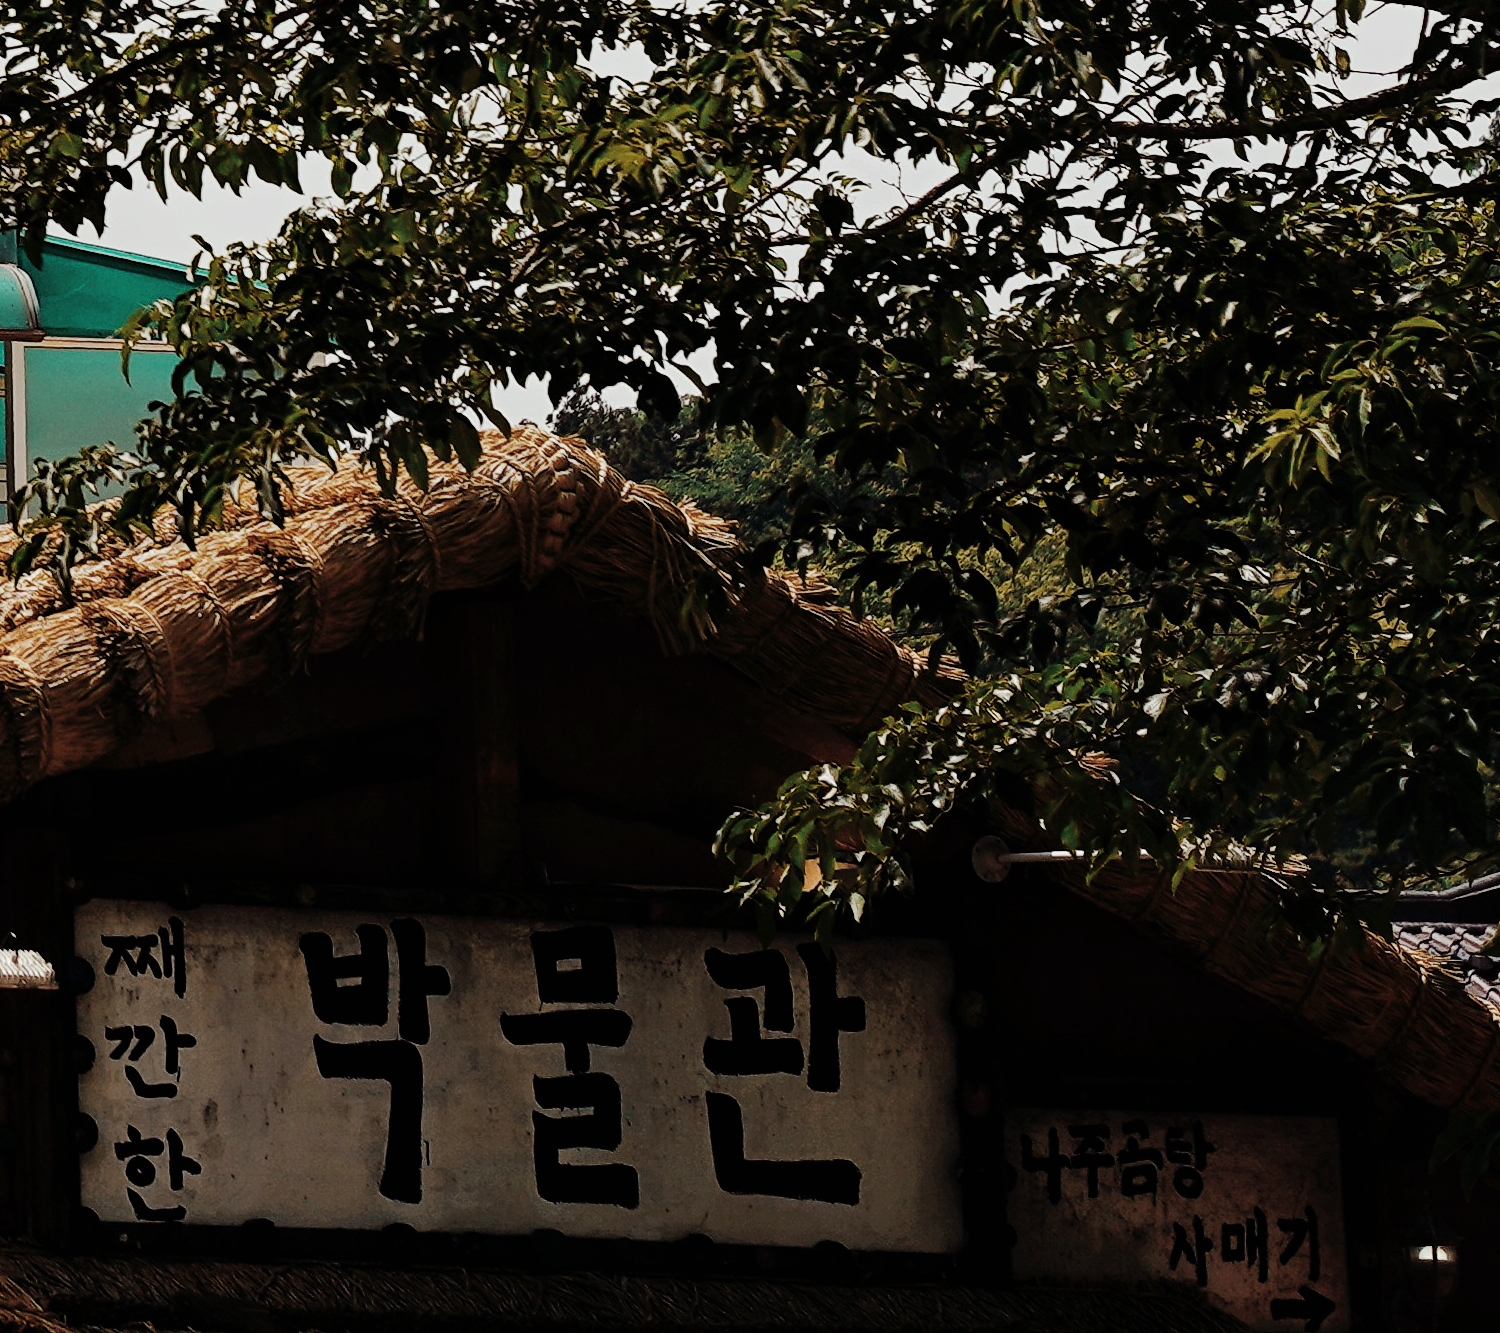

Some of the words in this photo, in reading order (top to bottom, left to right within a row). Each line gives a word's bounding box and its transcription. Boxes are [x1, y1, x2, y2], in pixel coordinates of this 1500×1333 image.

[101, 916, 202, 1222] 째깐한
[300, 916, 868, 1211] 박물관
[1021, 1118, 1218, 1206] 나주곰탕
[1169, 1204, 1320, 1288] 사매기
